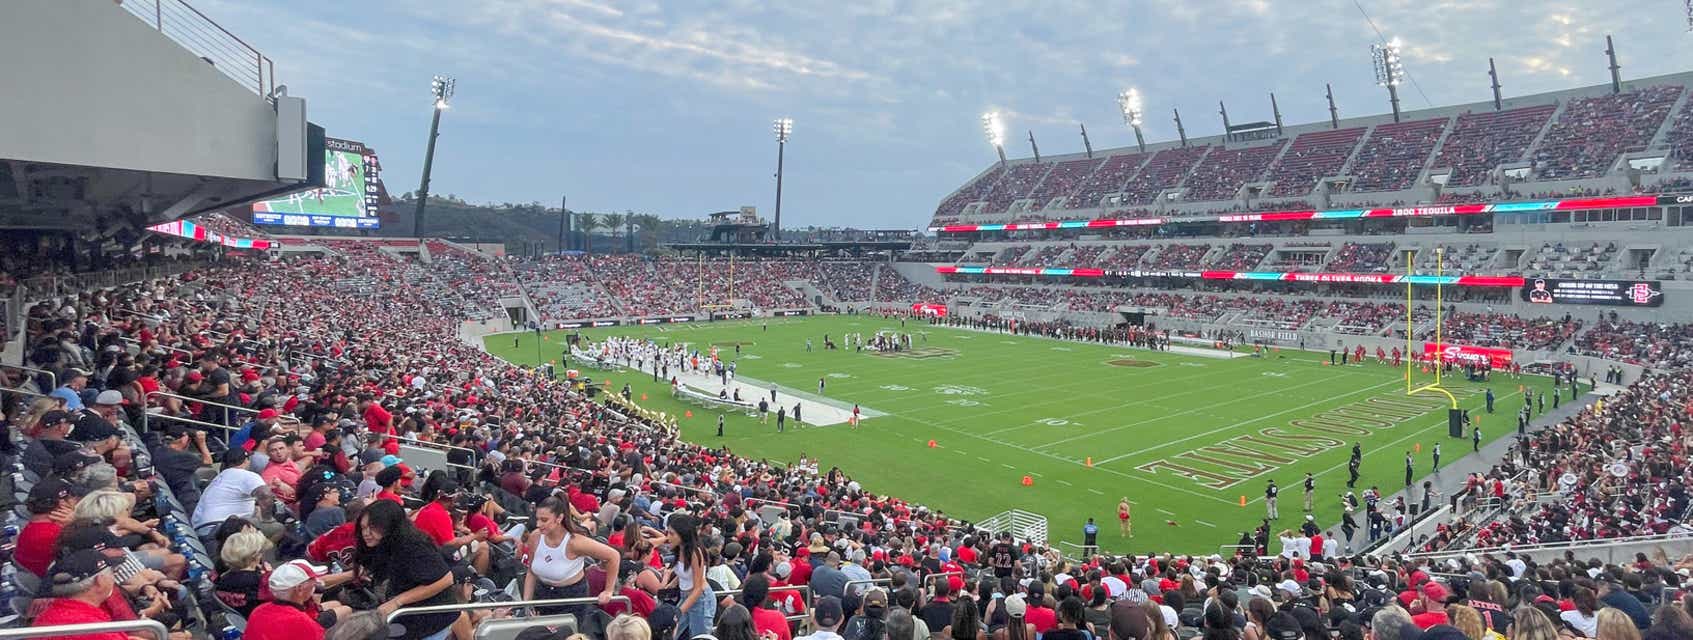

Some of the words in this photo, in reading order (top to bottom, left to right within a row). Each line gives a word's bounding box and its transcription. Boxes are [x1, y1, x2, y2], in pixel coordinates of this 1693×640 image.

[327, 140, 362, 151] stadium
[1392, 208, 1415, 216] 1800
[1417, 207, 1455, 216] TEQUILA
[1278, 332, 1298, 341] FIELD
[1134, 428, 1346, 491] STATE
[995, 552, 1012, 568] 22
